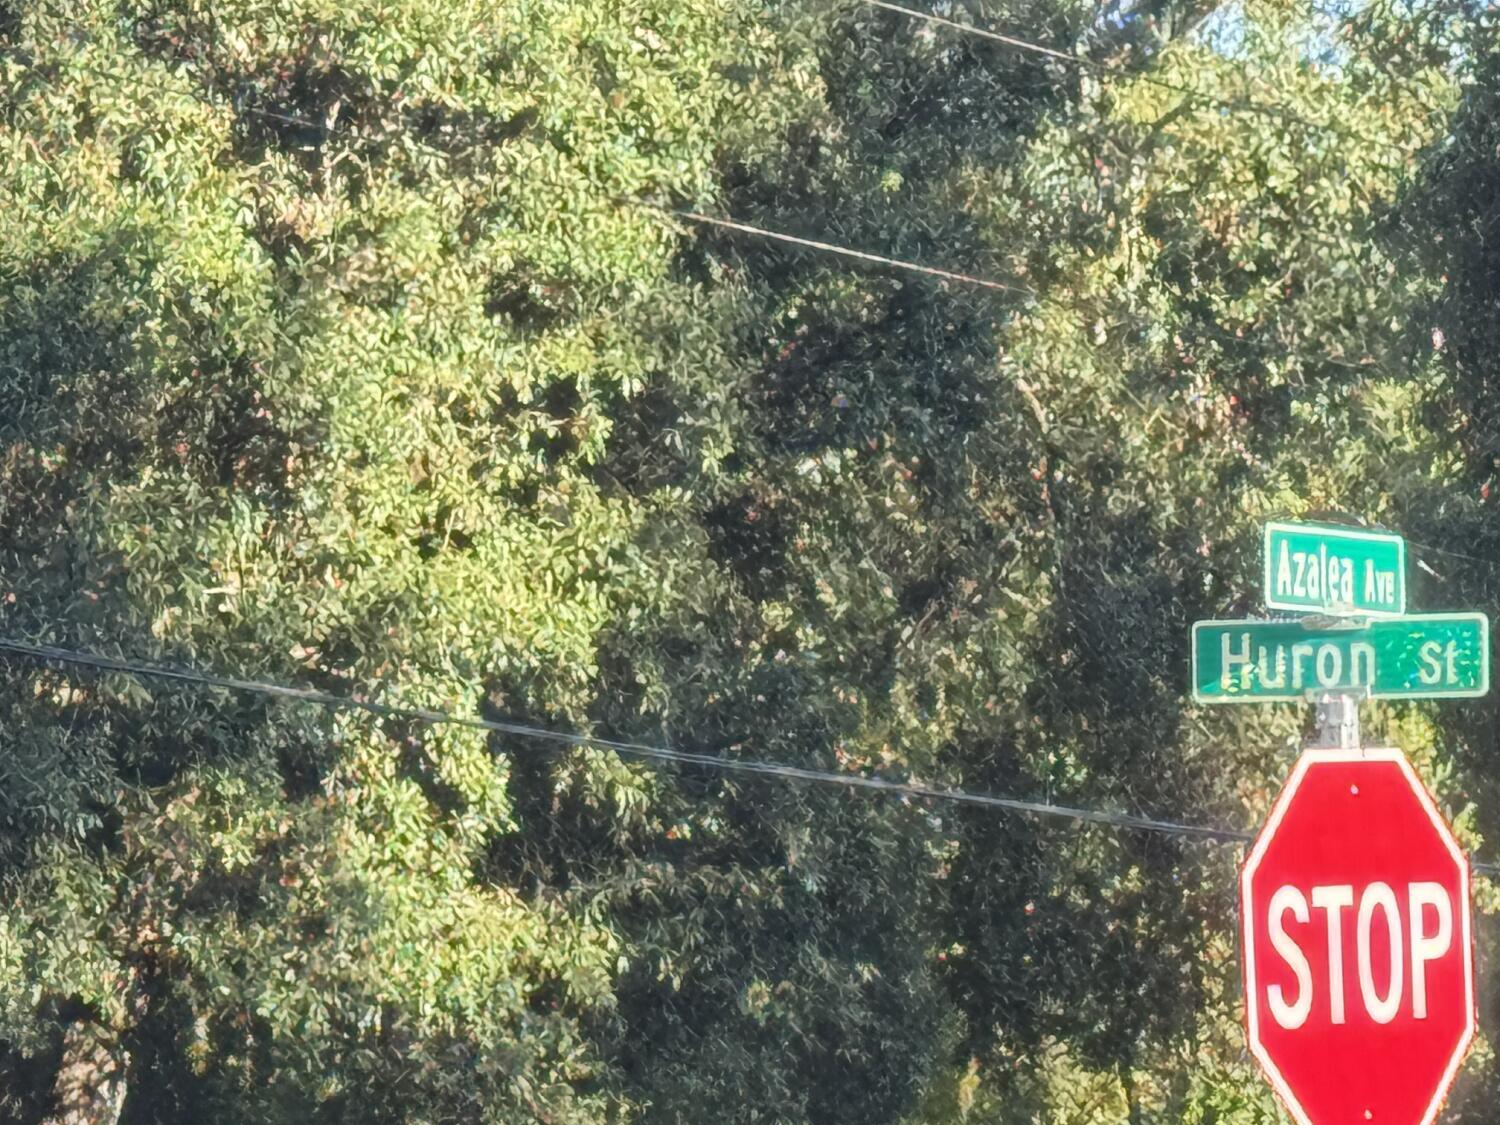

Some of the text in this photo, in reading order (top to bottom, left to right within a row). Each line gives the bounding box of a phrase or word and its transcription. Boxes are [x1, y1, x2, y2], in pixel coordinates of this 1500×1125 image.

[1277, 539, 1353, 602] Azalea
[1221, 632, 1459, 689] Huron St
[1266, 881, 1453, 1030] STOP
